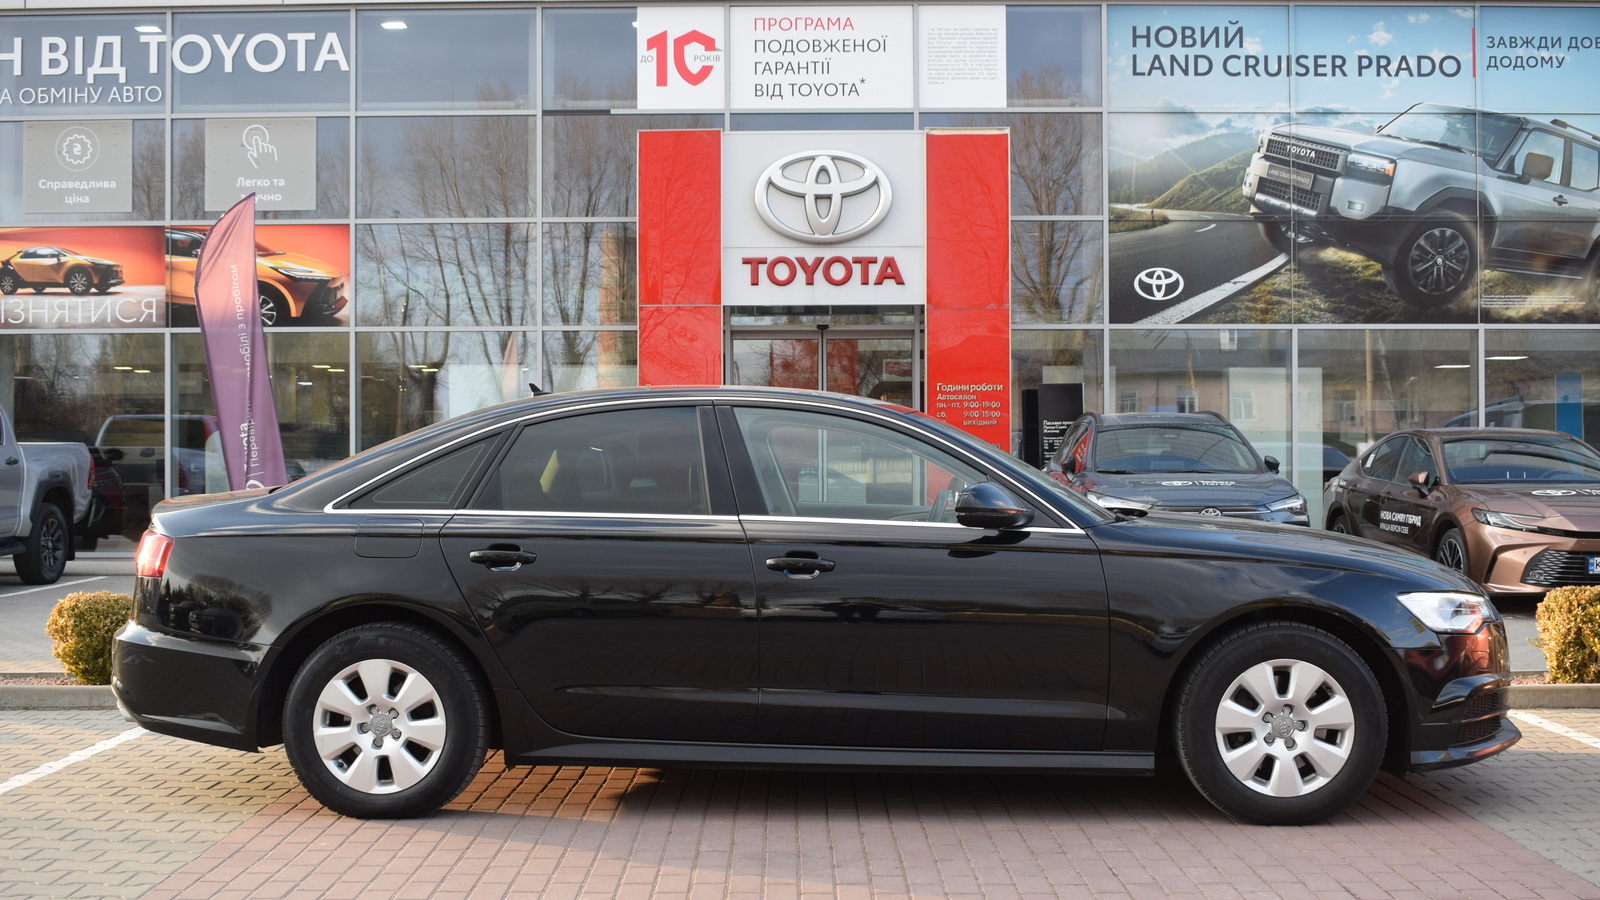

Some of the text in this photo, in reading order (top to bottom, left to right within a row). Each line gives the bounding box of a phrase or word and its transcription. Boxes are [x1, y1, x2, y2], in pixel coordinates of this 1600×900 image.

[754, 17, 854, 31] ПРОГРАМА
[1131, 20, 1244, 48] НОВИЙ
[754, 35, 888, 56] ПОДОВЖЕНОЇ
[1486, 36, 1562, 52] ЗАВЖДИ
[41, 35, 126, 84] ВІД
[139, 32, 349, 74] TOYOTA
[640, 55, 654, 64] ДО
[1131, 54, 1462, 77] LAND CRUISER PRADO
[1486, 56, 1565, 71] ДОДОМУ
[754, 57, 832, 75] ГАРАНТІЇ
[19, 87, 103, 105] ОБМІНУ
[107, 85, 163, 103] АВТО
[754, 83, 784, 100] ВІД
[1287, 145, 1315, 158] TOYOTA
[38, 179, 117, 191] Справедлива
[236, 177, 285, 187] Легко та
[64, 193, 90, 205] ціна
[240, 193, 282, 204] зучно
[742, 256, 906, 287] TOYOTA
[230, 264, 245, 321] пробігом
[936, 382, 1003, 392] Години роботи
[936, 393, 977, 401] Автосалон
[963, 418, 997, 426] вихідний
